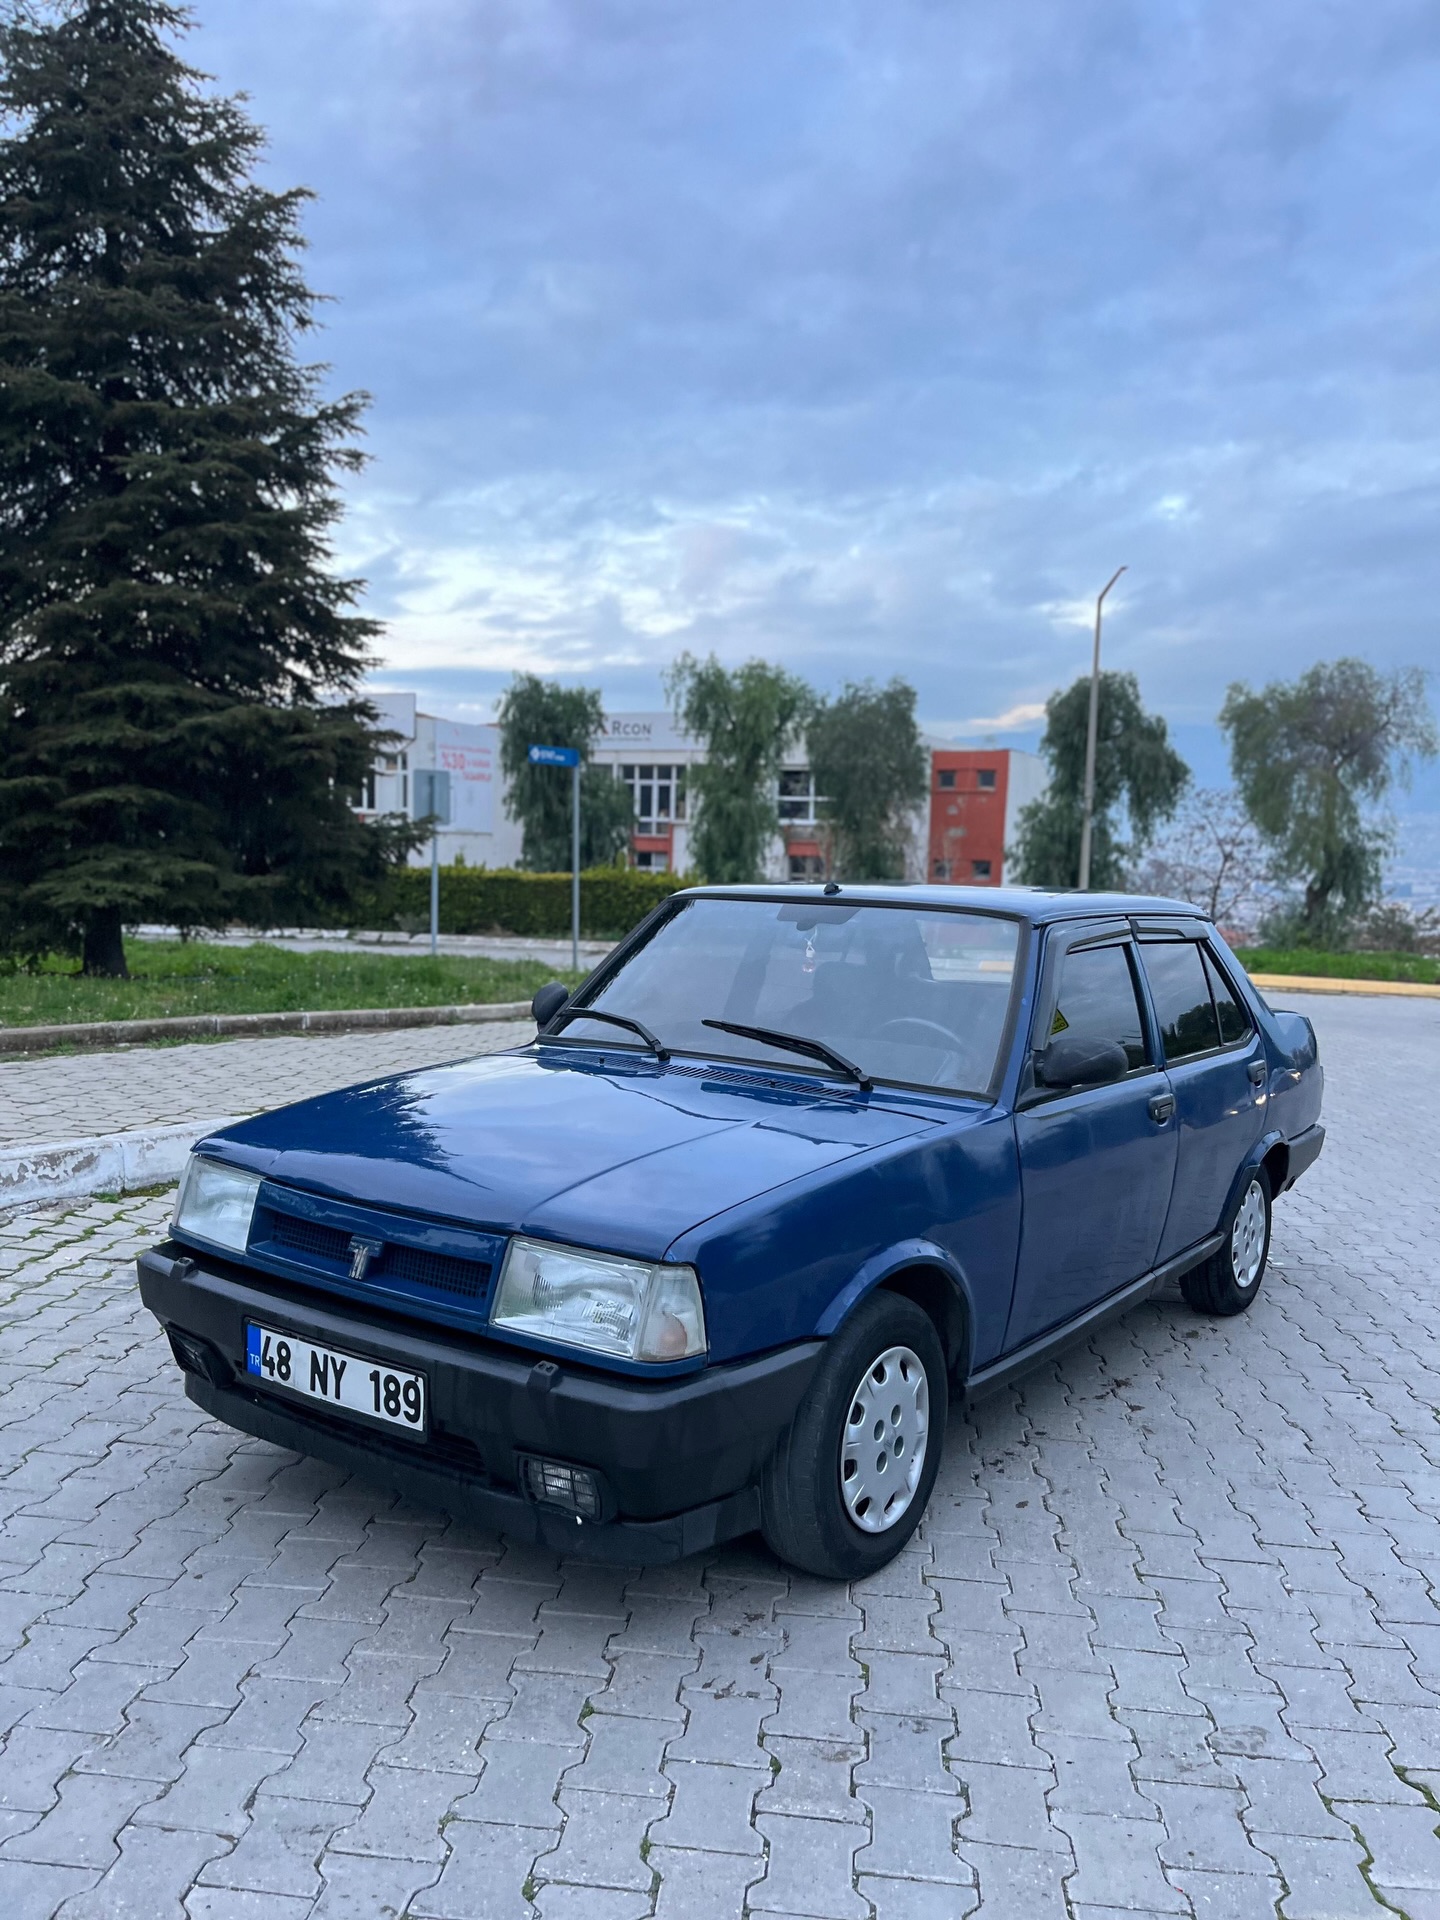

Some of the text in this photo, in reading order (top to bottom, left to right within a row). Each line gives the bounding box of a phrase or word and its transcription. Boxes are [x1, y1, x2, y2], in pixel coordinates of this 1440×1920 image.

[250, 1353, 260, 1367] TR
[262, 1335, 420, 1424] 48 NY 189
